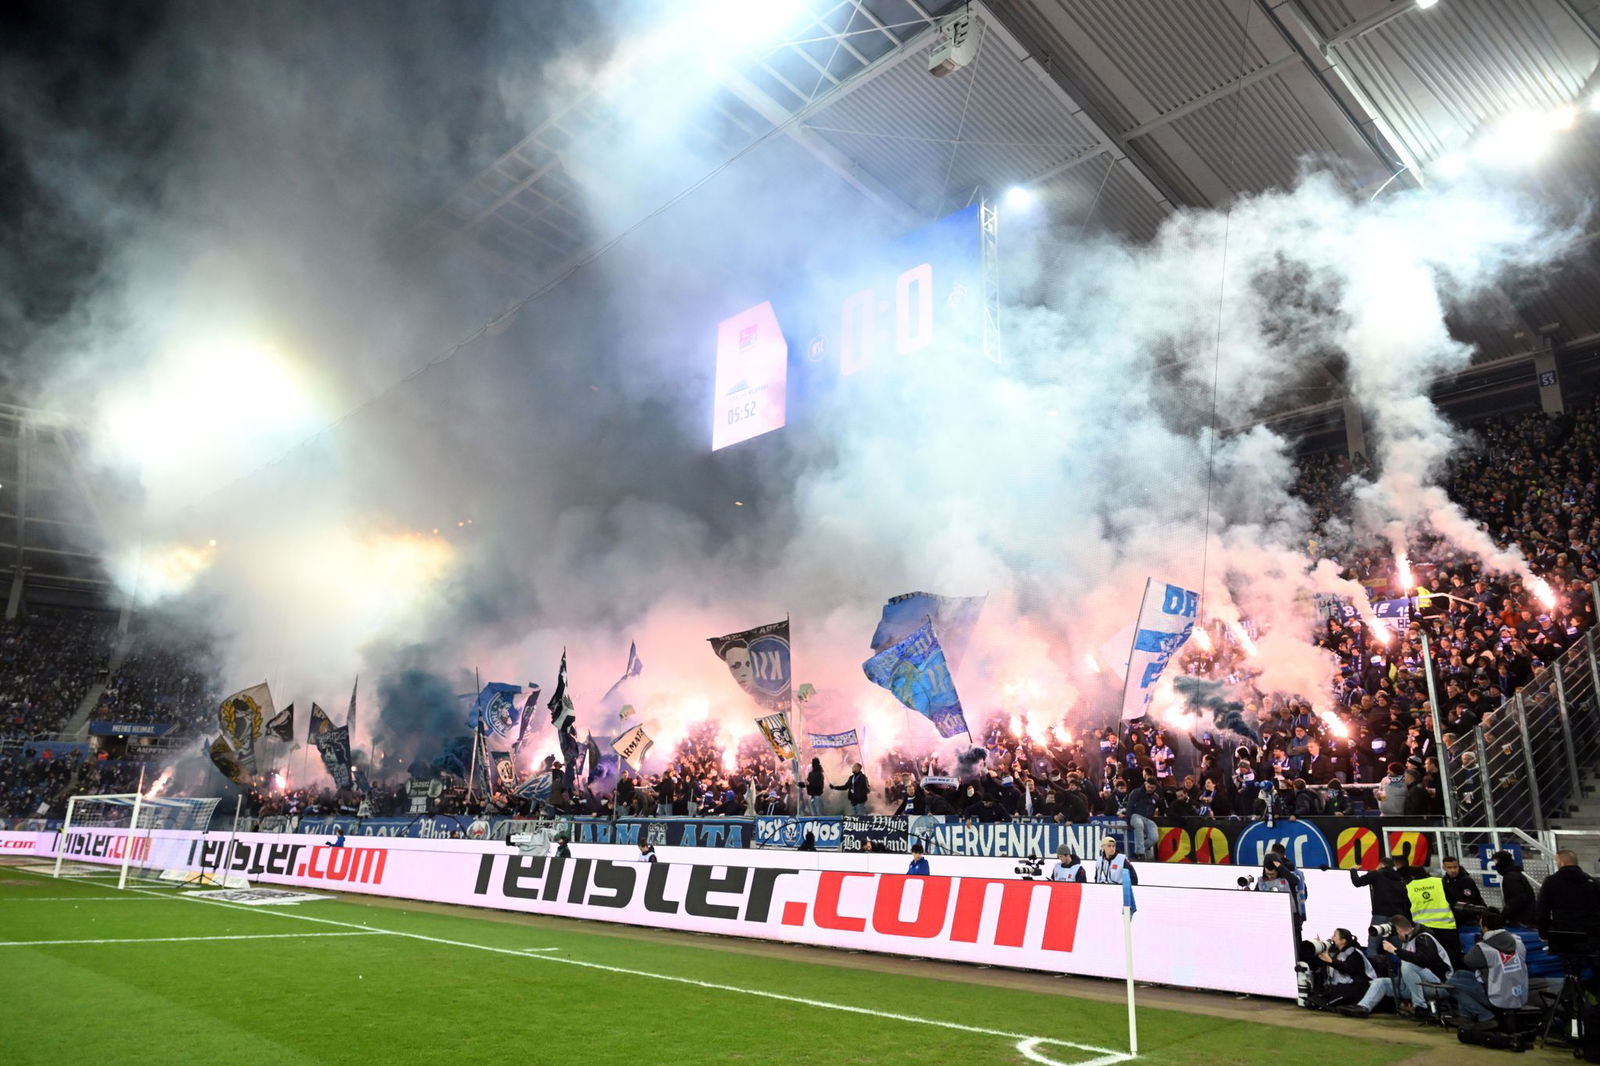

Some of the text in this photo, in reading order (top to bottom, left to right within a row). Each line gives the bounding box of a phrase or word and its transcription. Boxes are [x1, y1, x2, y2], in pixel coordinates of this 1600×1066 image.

[728, 401, 756, 425] 05:52
[757, 819, 782, 842] PSY
[843, 815, 907, 834] Blue-White
[0, 840, 37, 849] .com
